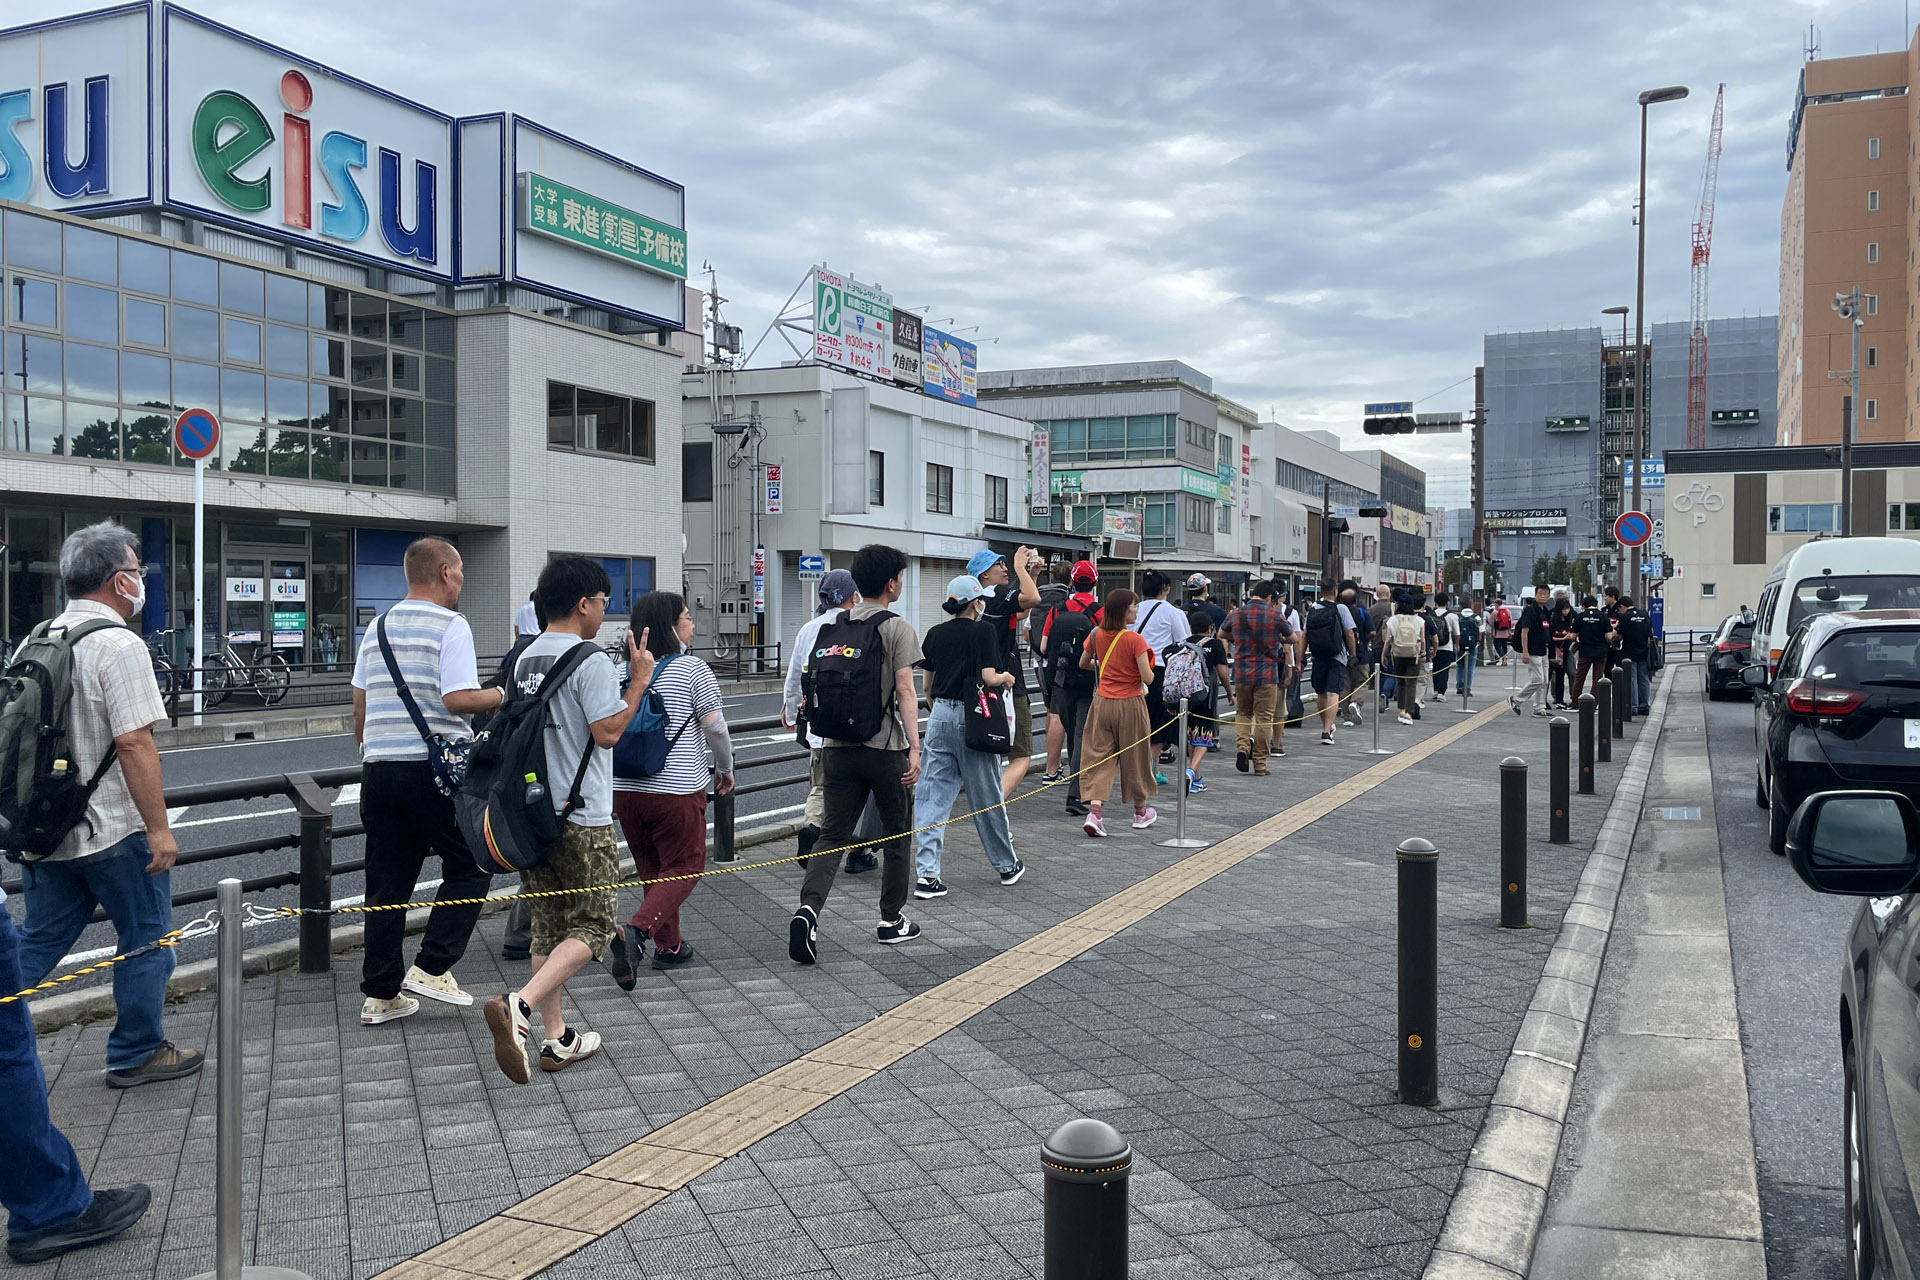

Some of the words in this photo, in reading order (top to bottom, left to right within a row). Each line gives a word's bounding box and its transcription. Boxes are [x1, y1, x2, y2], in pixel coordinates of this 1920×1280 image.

[192, 69, 437, 265] eisu
[534, 184, 558, 205] 大学
[534, 204, 558, 227] 受験
[563, 199, 685, 269] 東進衛星予備校
[816, 270, 842, 288] TOYOTA
[816, 333, 842, 348] レンタカー
[816, 346, 842, 361] カーリース
[769, 489, 779, 499] P
[1485, 509, 1564, 519] 新築マンションプロジェクト
[1693, 512, 1707, 528] P
[234, 581, 256, 593] eisu
[277, 582, 298, 594] eisu
[815, 644, 862, 659] adidas
